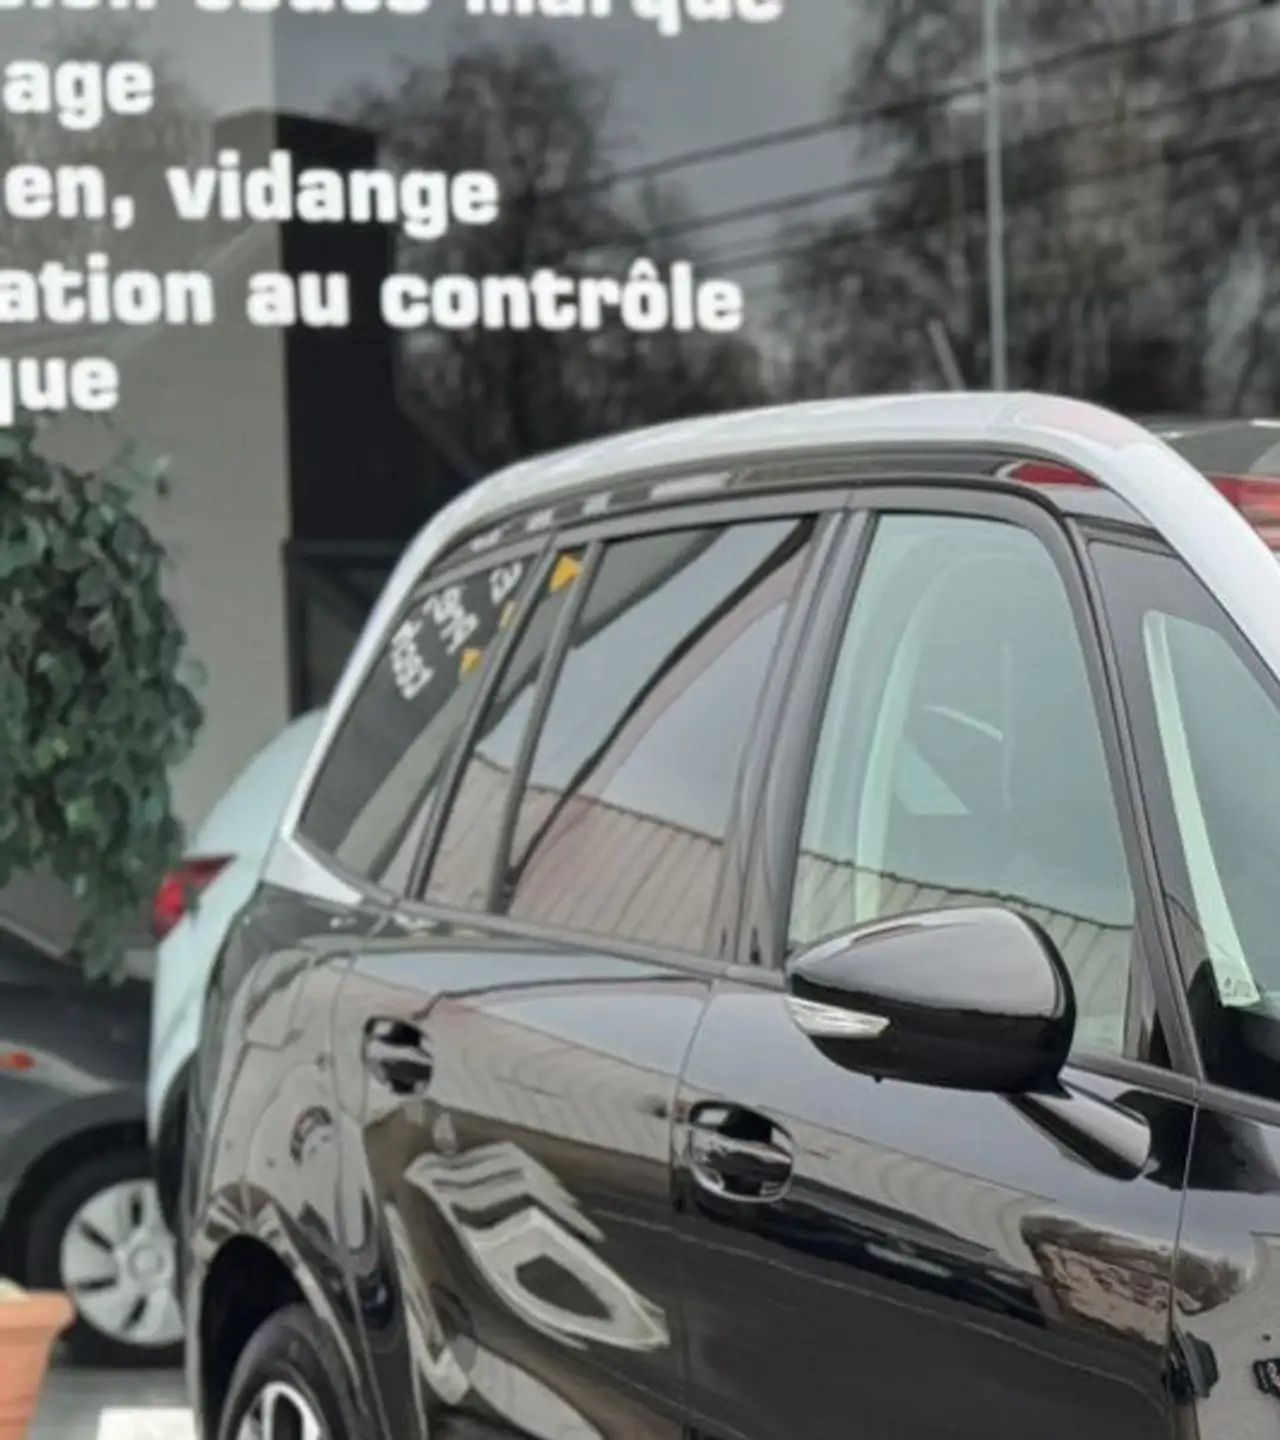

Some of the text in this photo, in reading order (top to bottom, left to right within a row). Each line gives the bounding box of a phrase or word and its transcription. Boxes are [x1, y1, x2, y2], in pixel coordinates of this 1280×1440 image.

[5, 149, 500, 241] en, vidange
[247, 271, 350, 327] au
[379, 257, 744, 332] contrôle
